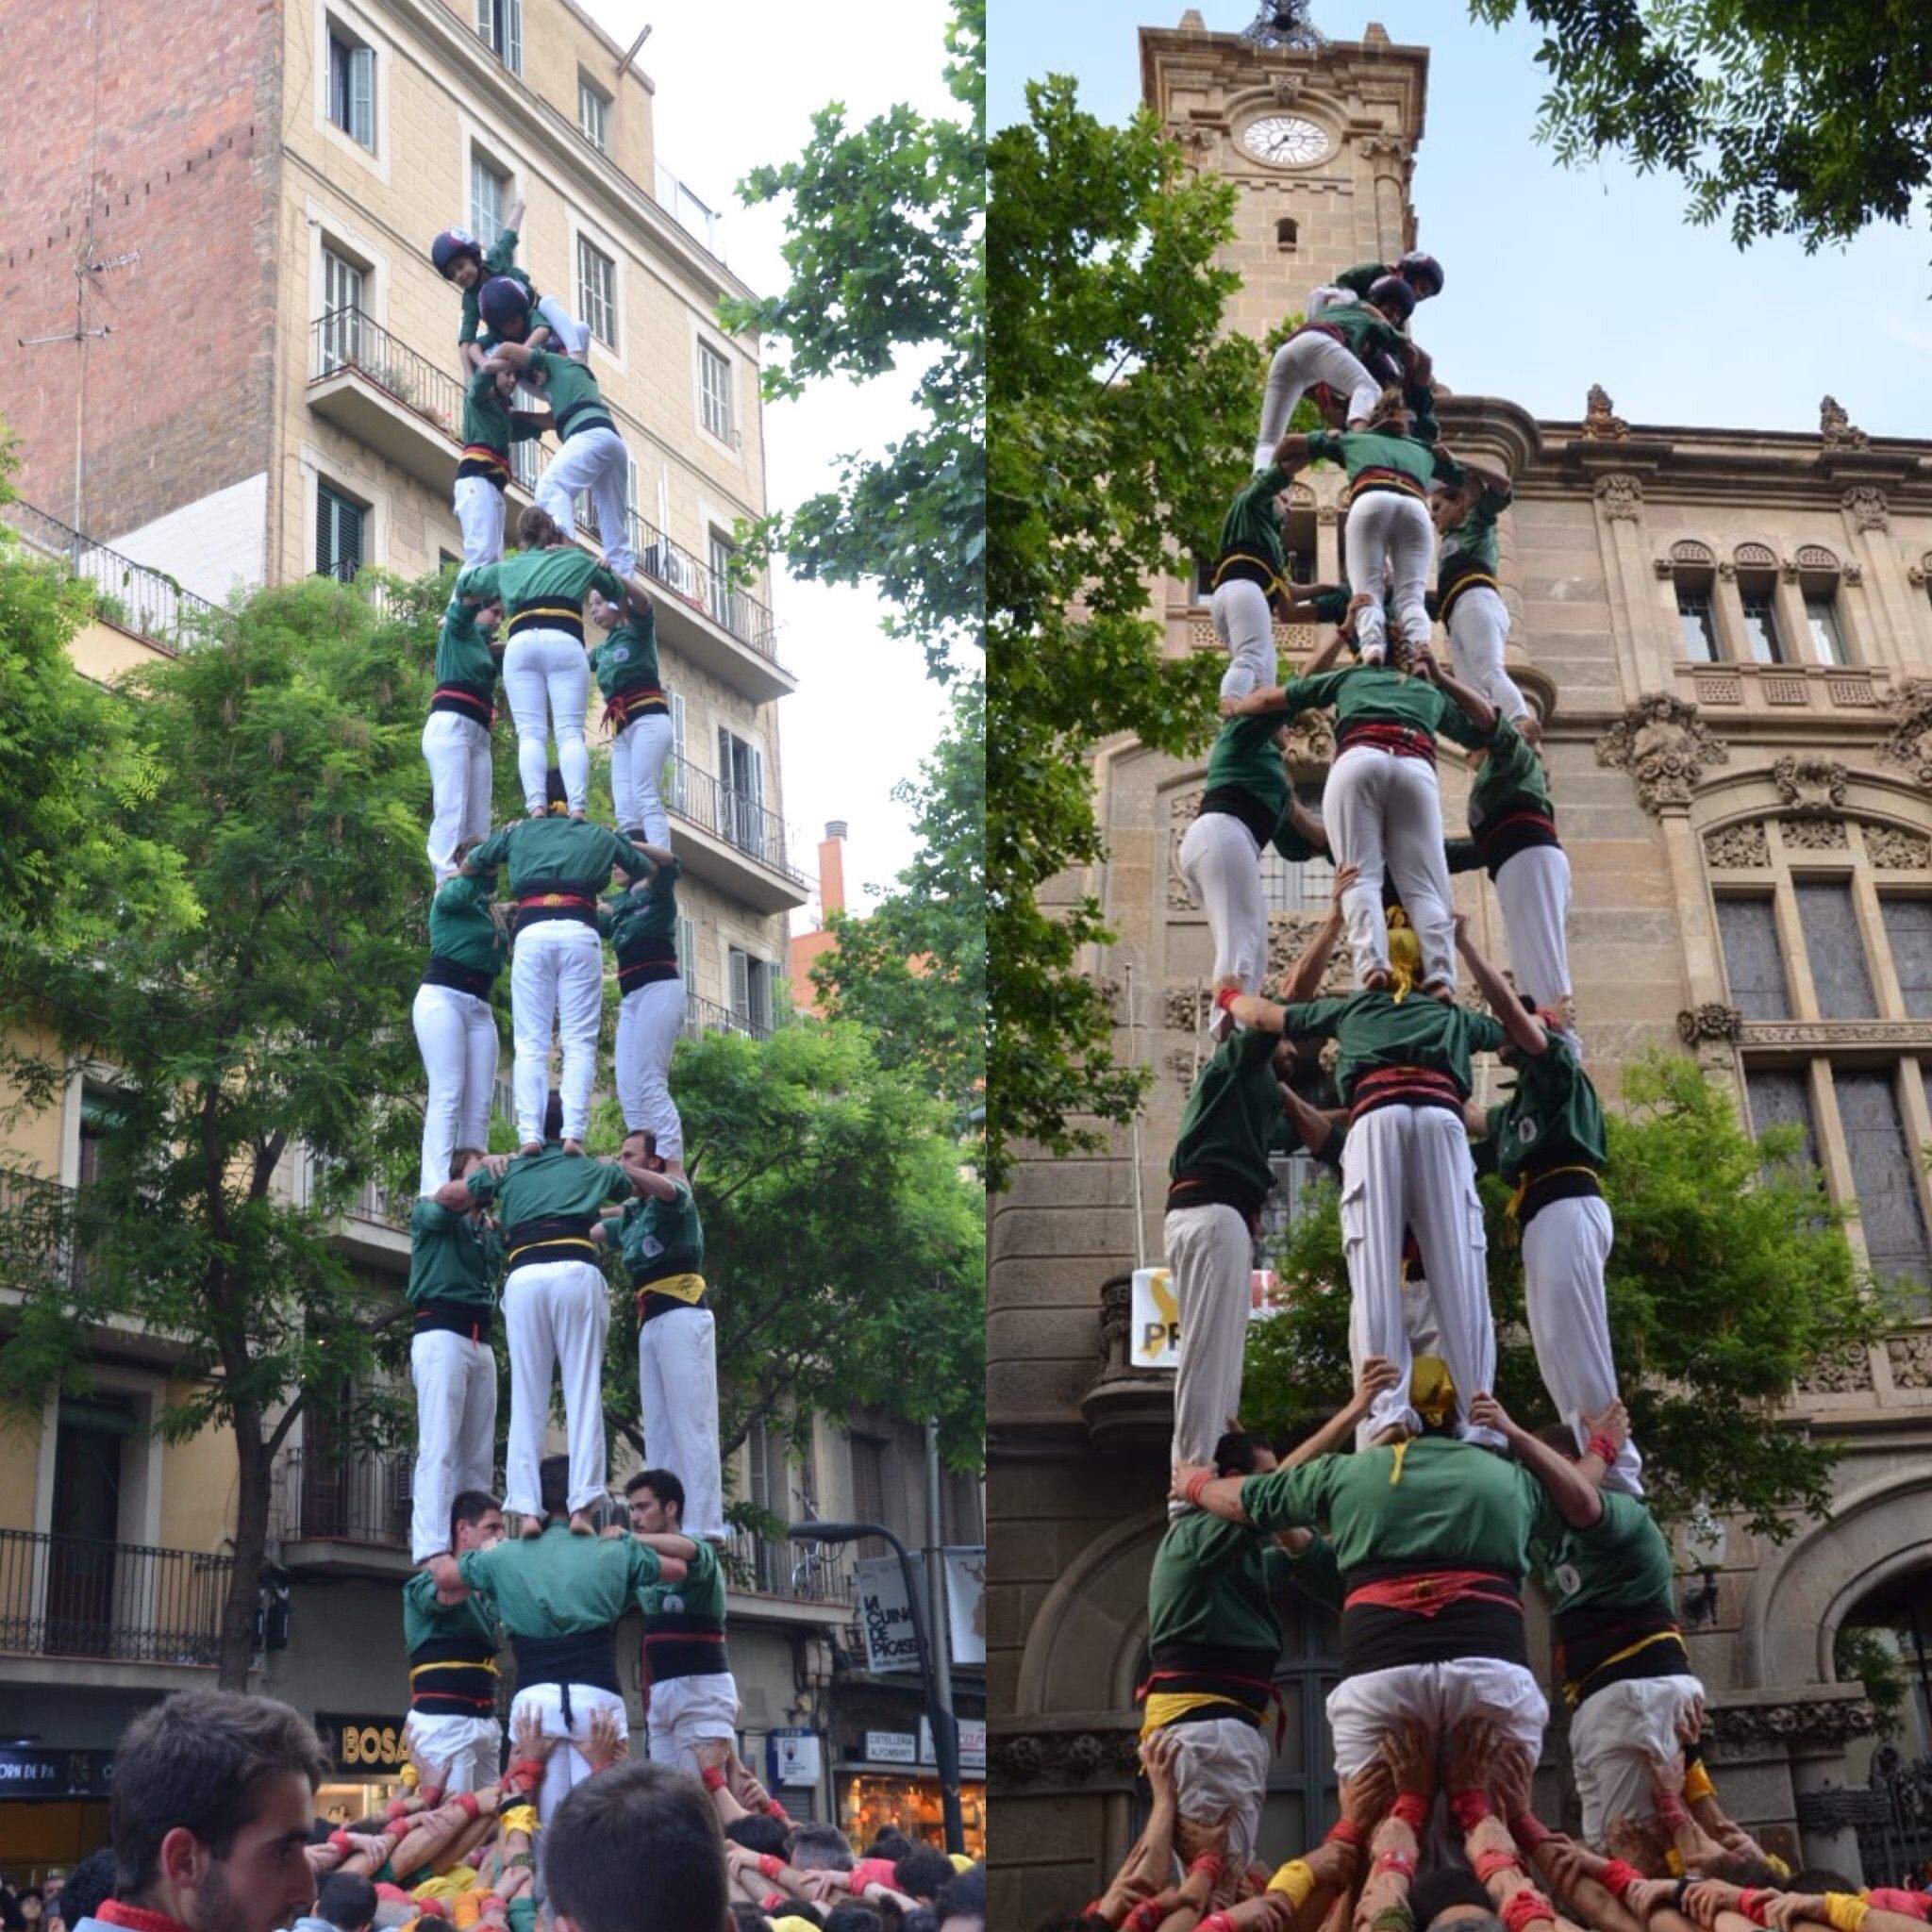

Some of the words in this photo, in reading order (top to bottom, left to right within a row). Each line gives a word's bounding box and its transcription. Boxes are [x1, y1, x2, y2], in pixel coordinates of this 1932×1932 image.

[864, 1595, 879, 1611] LA
[869, 1626, 888, 1642] DE
[24, 1764, 37, 1780] DE
